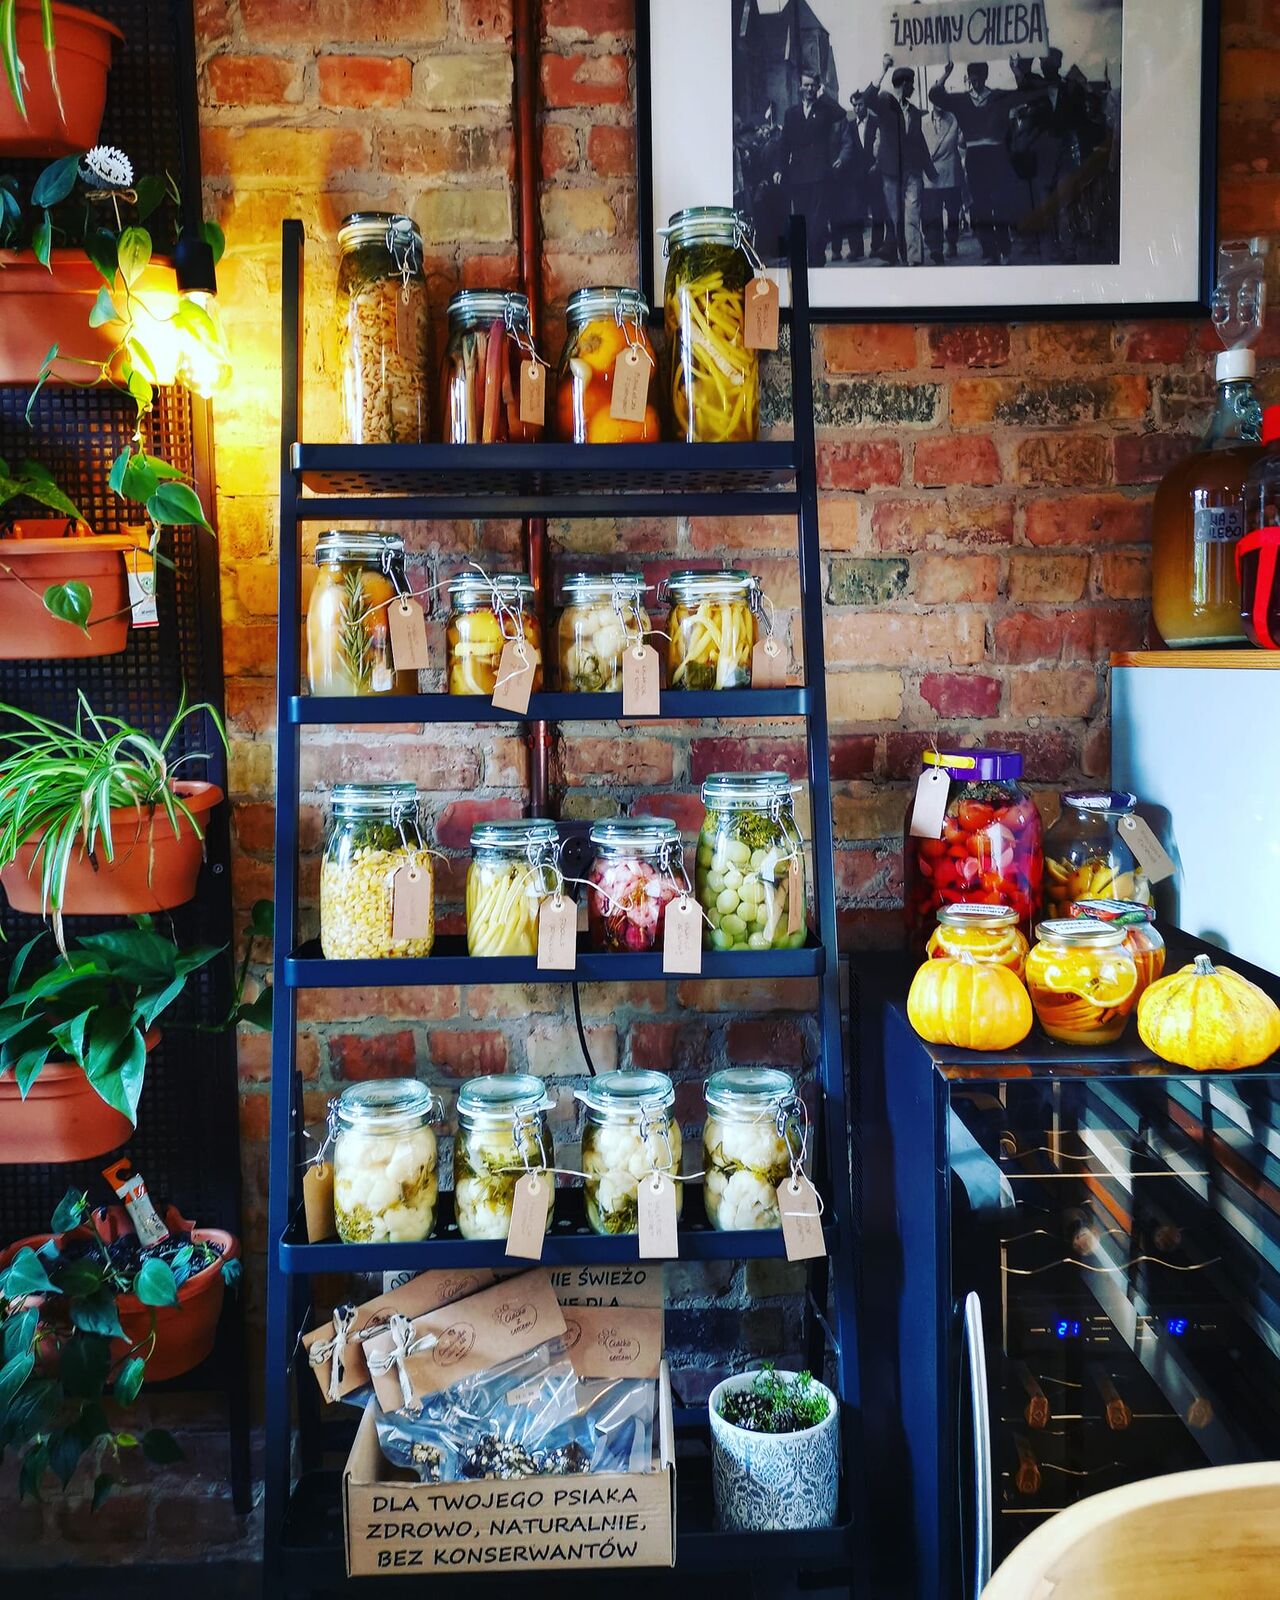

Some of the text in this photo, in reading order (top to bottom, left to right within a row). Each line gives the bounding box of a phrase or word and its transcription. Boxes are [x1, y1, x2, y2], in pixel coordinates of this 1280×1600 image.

[890, 3, 1043, 51] ŻĄDAMY CHLEBA
[578, 1266, 647, 1287] ŚWIEŻO
[1057, 1320, 1080, 1337] 21
[373, 1487, 638, 1513] DLA TWOJEGO PSIAKA
[366, 1513, 647, 1540] ZDROWO, NATURALNIE,
[378, 1536, 638, 1568] BEZ KONSERWANTÓW
